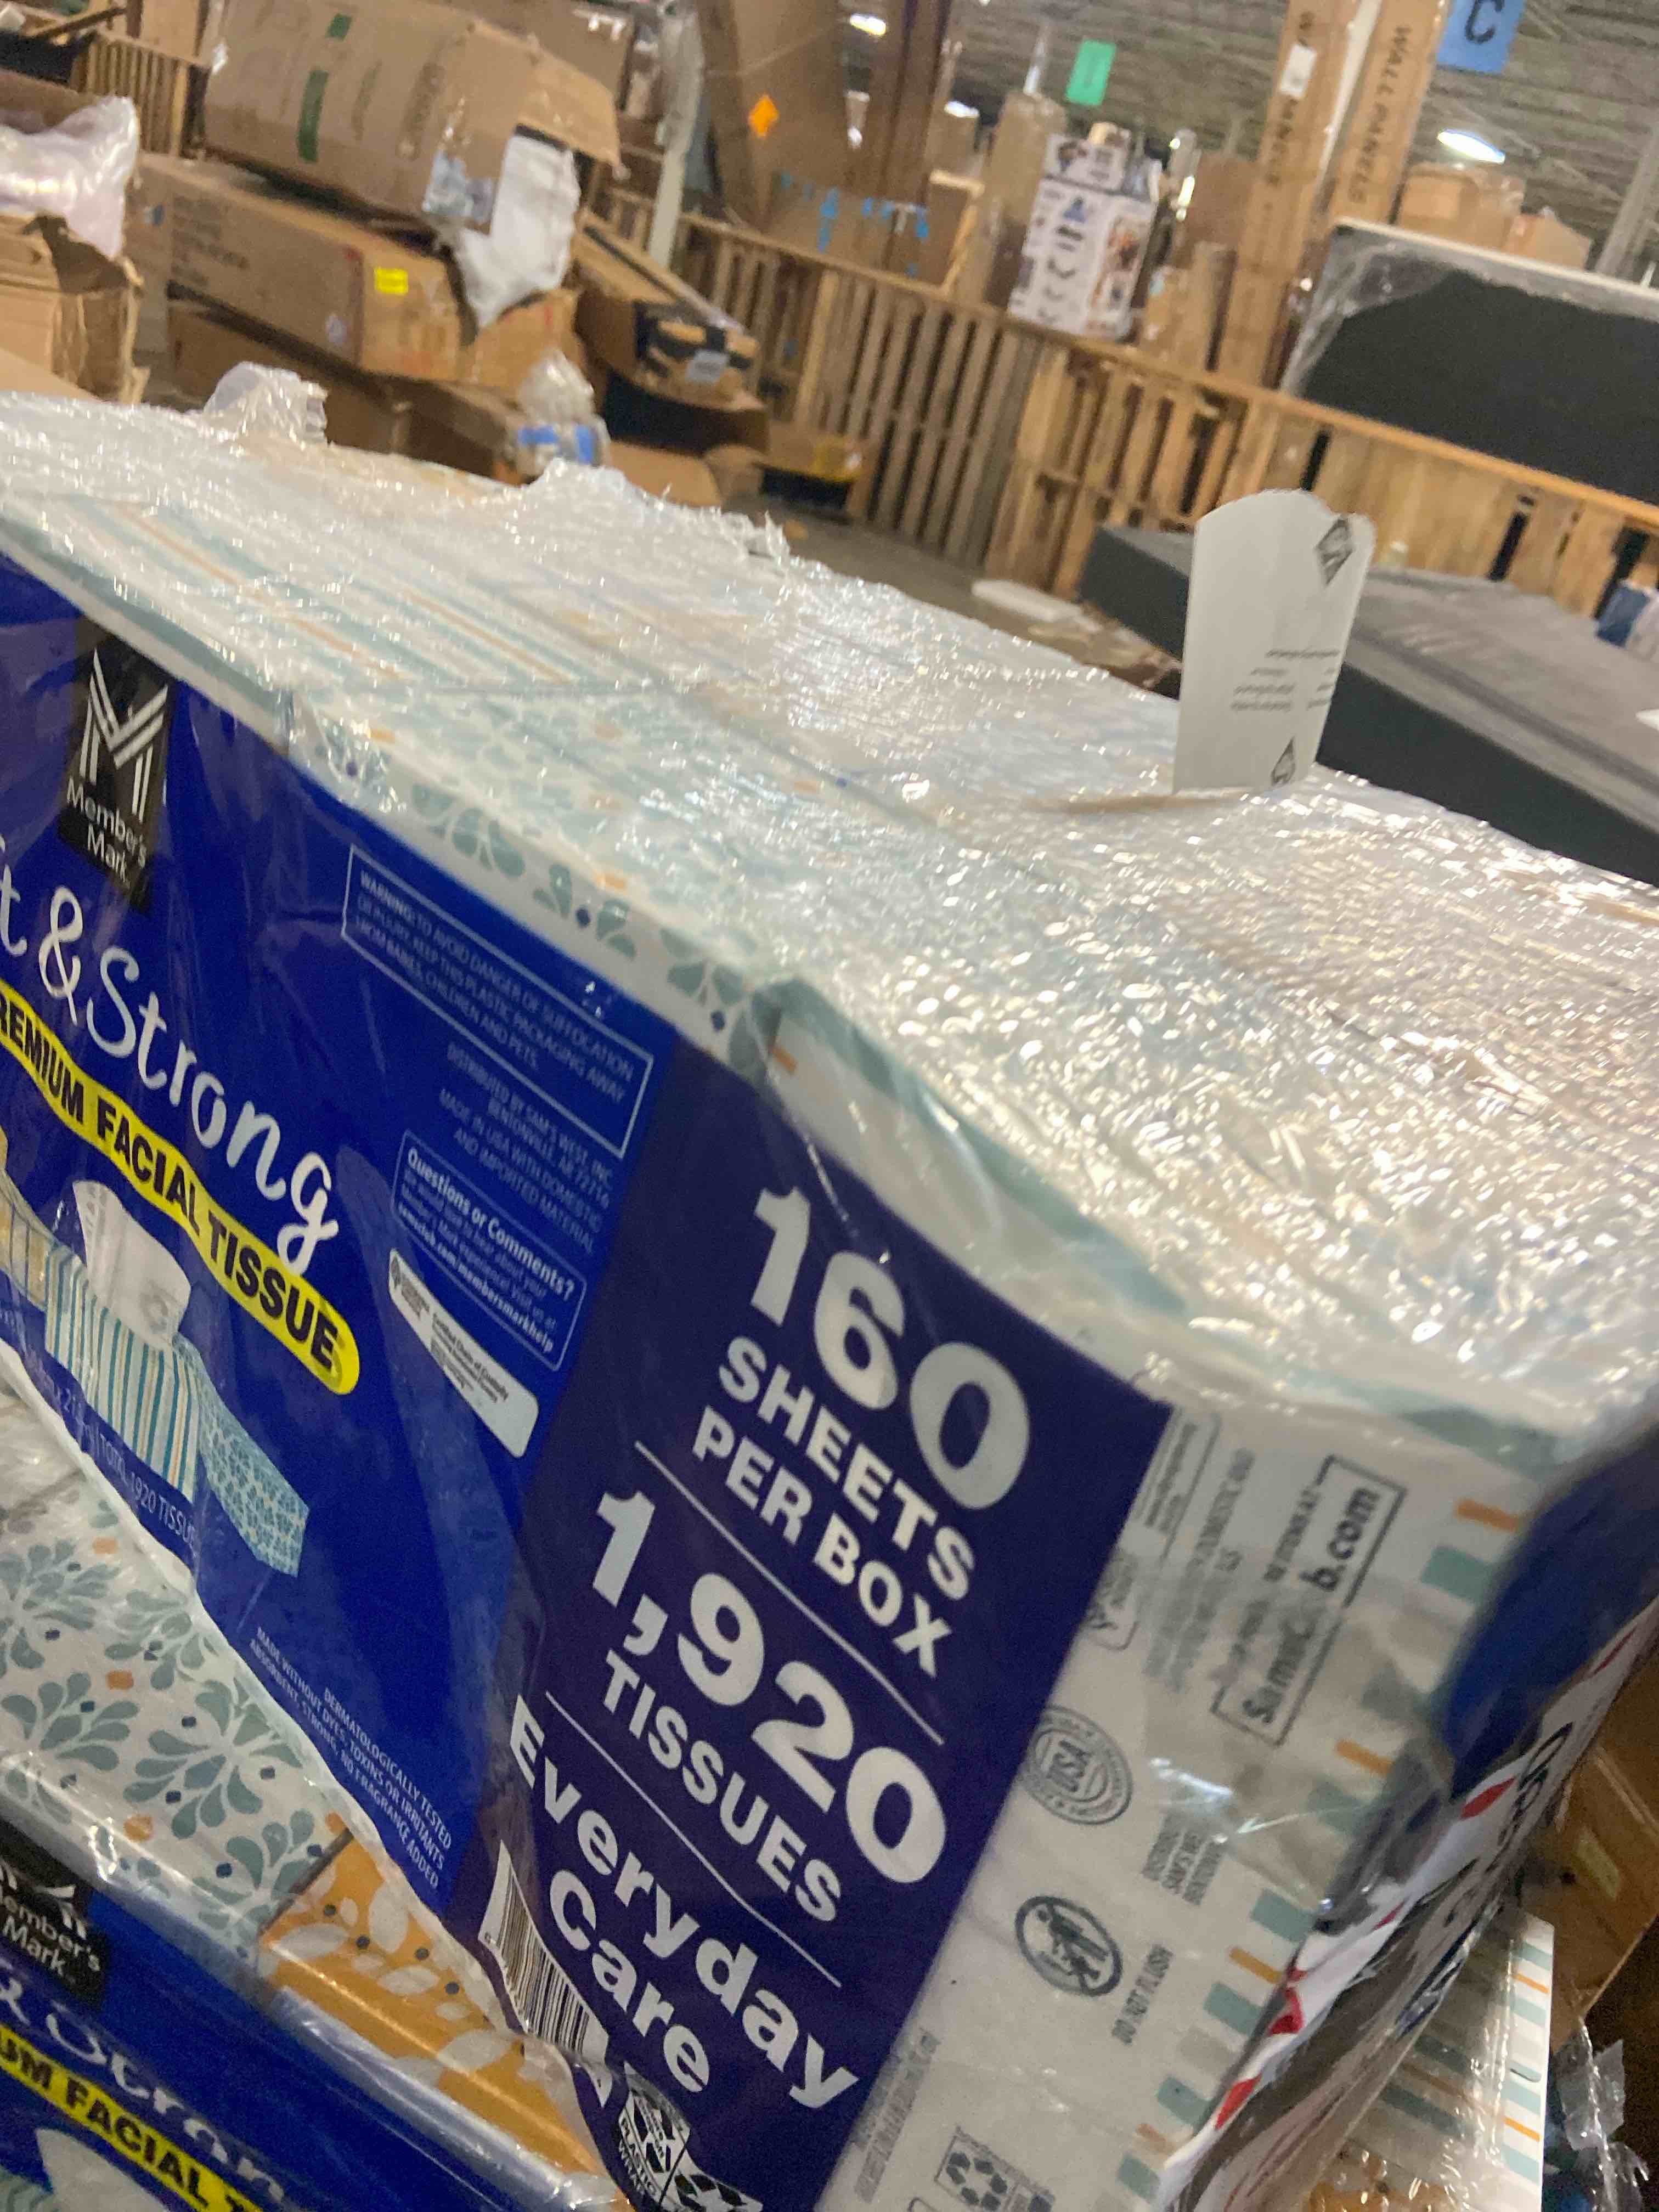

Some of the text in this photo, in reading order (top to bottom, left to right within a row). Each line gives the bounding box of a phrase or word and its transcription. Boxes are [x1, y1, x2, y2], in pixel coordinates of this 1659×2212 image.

[1465, 0, 1504, 44] C
[66, 776, 146, 870] Member's
[87, 824, 129, 883] Mark
[0, 991, 340, 1370] REMIUM FACIAL TISSUE
[38, 884, 339, 1276] & Strong
[408, 1148, 471, 1215] Questions
[471, 1207, 487, 1229] or
[487, 1216, 575, 1302] Comments?
[749, 1186, 1030, 1510] 160
[691, 1404, 814, 1546] PER
[812, 1512, 953, 1679] BOX
[719, 1336, 975, 1601] SHEETS
[281, 1656, 321, 1712] WITHOUT
[349, 1738, 383, 1786] TOXINS
[385, 1780, 399, 1804] OR
[400, 1796, 445, 1870] IRRITANTS
[324, 1686, 452, 1850] DERMATOLOGICALLY TESTED
[592, 1489, 946, 1884] 1,920
[603, 1650, 842, 1922] TISSUES
[340, 1748, 354, 1775] NO
[354, 1768, 411, 1845] FRAGRANCE
[509, 1693, 859, 2110] Everyday
[0, 1893, 101, 1973] ember's
[2, 1915, 67, 1976] Mark
[549, 1869, 710, 2093] Care
[65, 2078, 210, 2208] FACIAL
